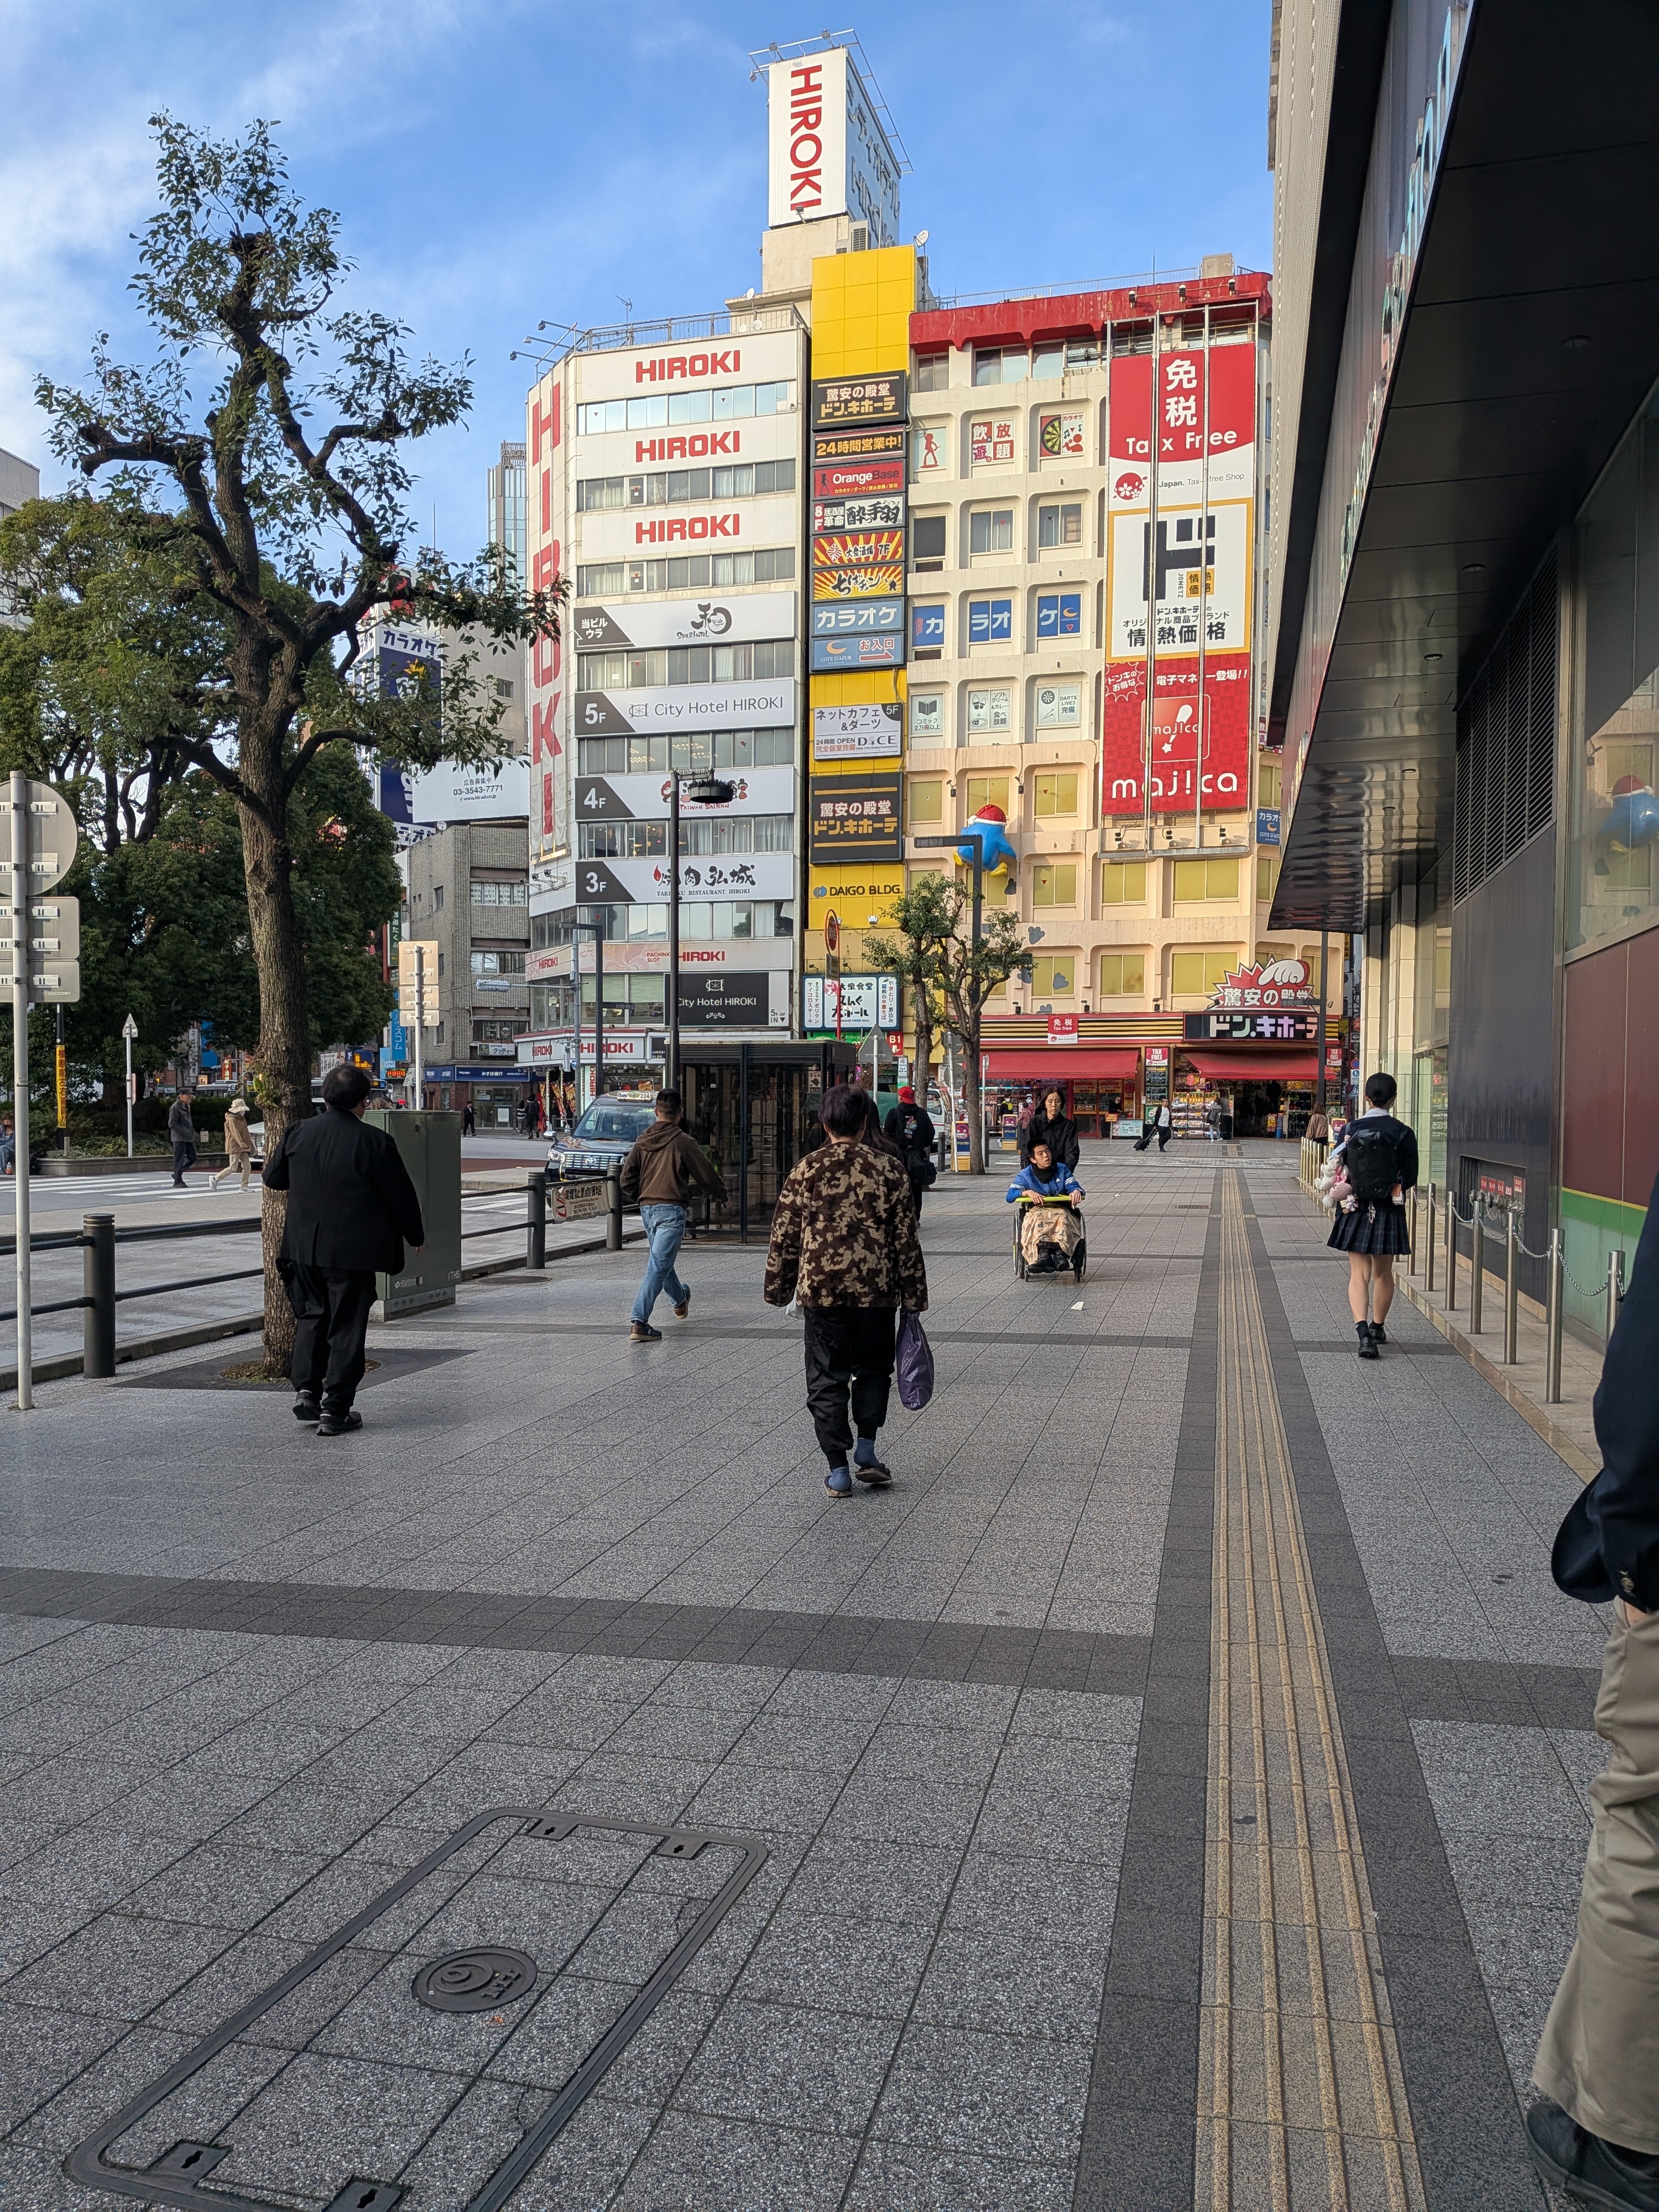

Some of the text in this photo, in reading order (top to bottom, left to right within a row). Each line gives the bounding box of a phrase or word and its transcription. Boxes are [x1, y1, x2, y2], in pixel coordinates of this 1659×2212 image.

[790, 64, 822, 211] HIROKI
[636, 350, 740, 383] HIROKI
[827, 383, 890, 402] 驚安の殿堂
[1166, 359, 1197, 427] 免税
[636, 430, 740, 462] HIROKI
[1126, 430, 1237, 454] Tax Free
[1159, 479, 1185, 488] Japan.
[1226, 473, 1244, 482] Shop
[824, 507, 844, 516] 居酒屋
[824, 515, 844, 526] 革命
[636, 513, 740, 544] HIROKI
[846, 543, 890, 558] 大衆酒場 7F
[581, 618, 608, 629] 当ビル
[818, 607, 896, 628] カラオケ
[586, 628, 603, 639] ウラ
[1128, 622, 1225, 647] 情熱価格
[860, 638, 894, 651] お入口
[1108, 671, 1136, 685] ドンキの
[1113, 679, 1135, 692] お得な
[585, 696, 784, 724] 5F City Hotel HIROKI
[816, 708, 880, 721] ネットカフェ
[886, 705, 899, 714] 5F
[841, 719, 881, 731] &ダーツ
[816, 744, 856, 753] 完全個室完備
[464, 777, 492, 786] 広告募集中
[453, 784, 503, 795] 03-3543-7771
[584, 787, 606, 808] 4F
[820, 800, 891, 817] 驚安の殿堂
[586, 872, 607, 893] 3F
[830, 884, 903, 896] DAIGO BLDG.
[539, 957, 558, 969] HIROKI
[679, 997, 757, 1008] City Hotel HIROKI
[532, 1044, 552, 1057] HIROKI
